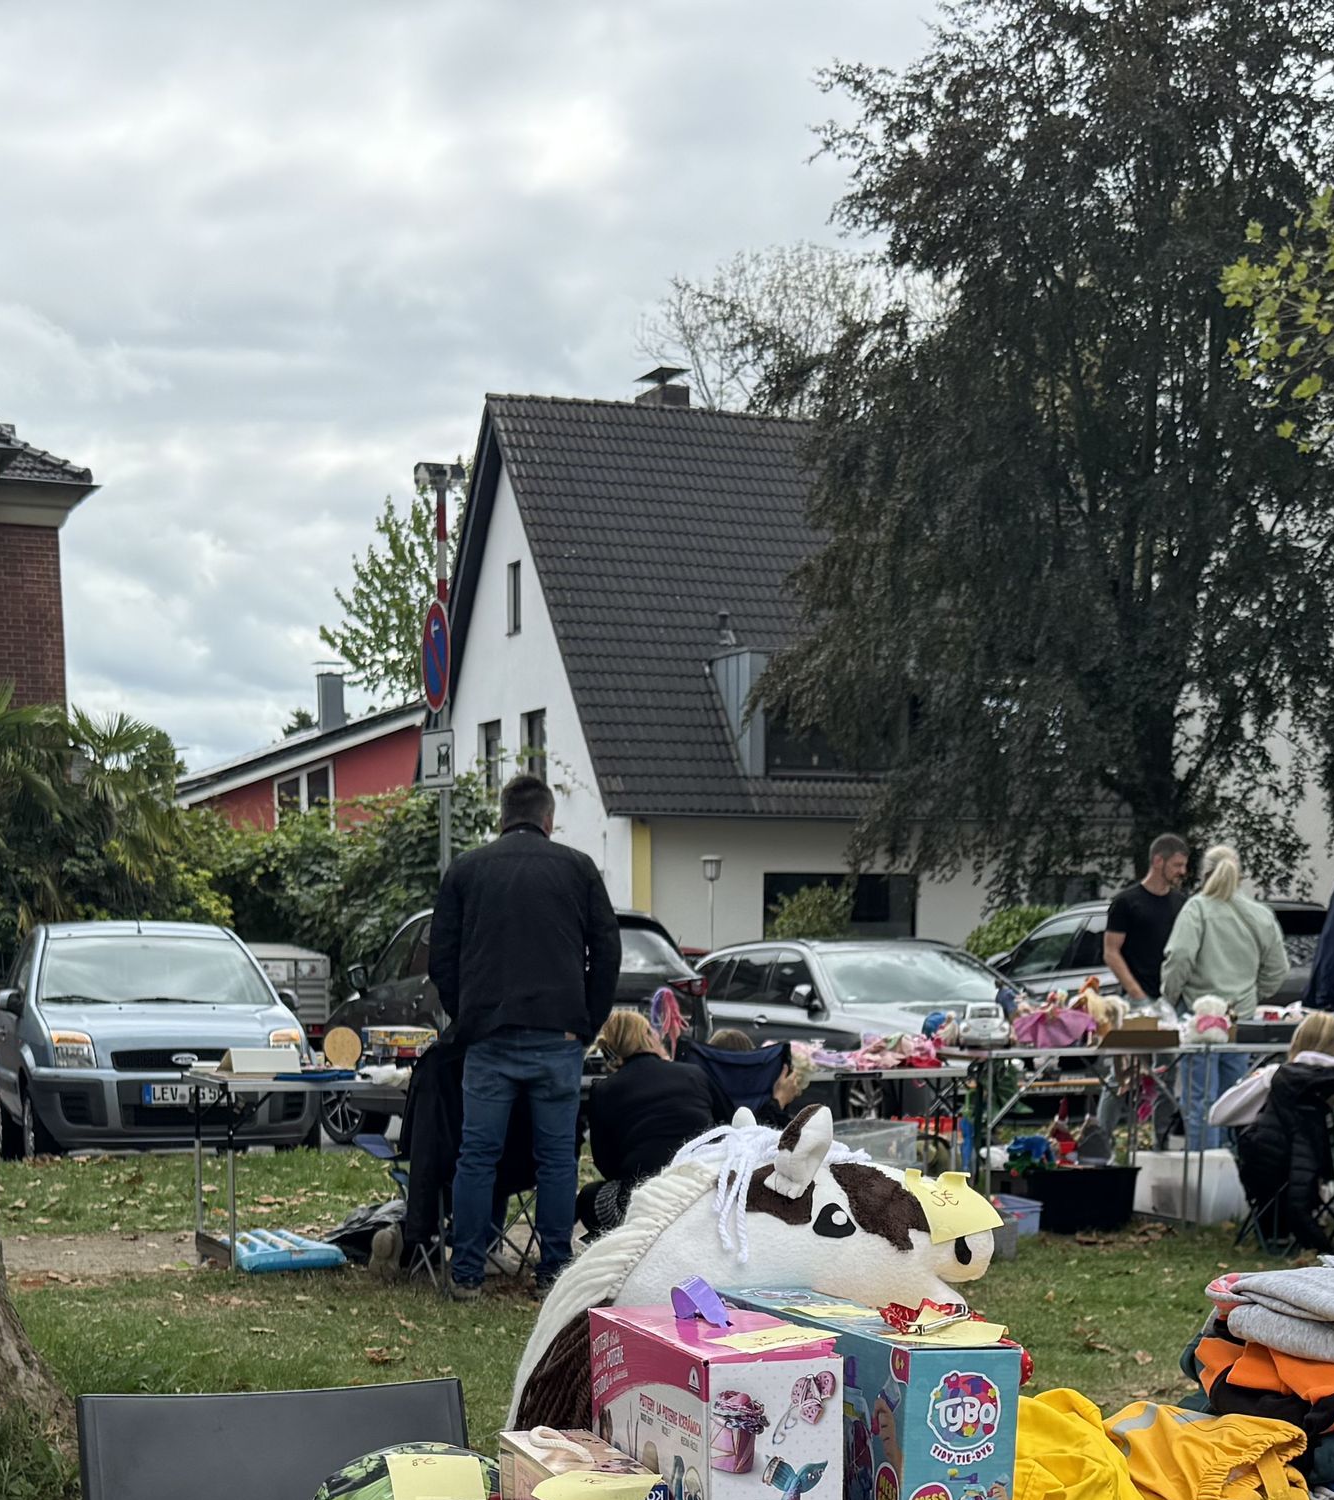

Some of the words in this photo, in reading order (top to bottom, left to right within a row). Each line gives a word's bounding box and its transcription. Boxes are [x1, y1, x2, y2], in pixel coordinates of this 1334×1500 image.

[152, 1086, 179, 1101] LEV
[930, 1443, 955, 1464] TIDY
[878, 1473, 898, 1500] MESS
